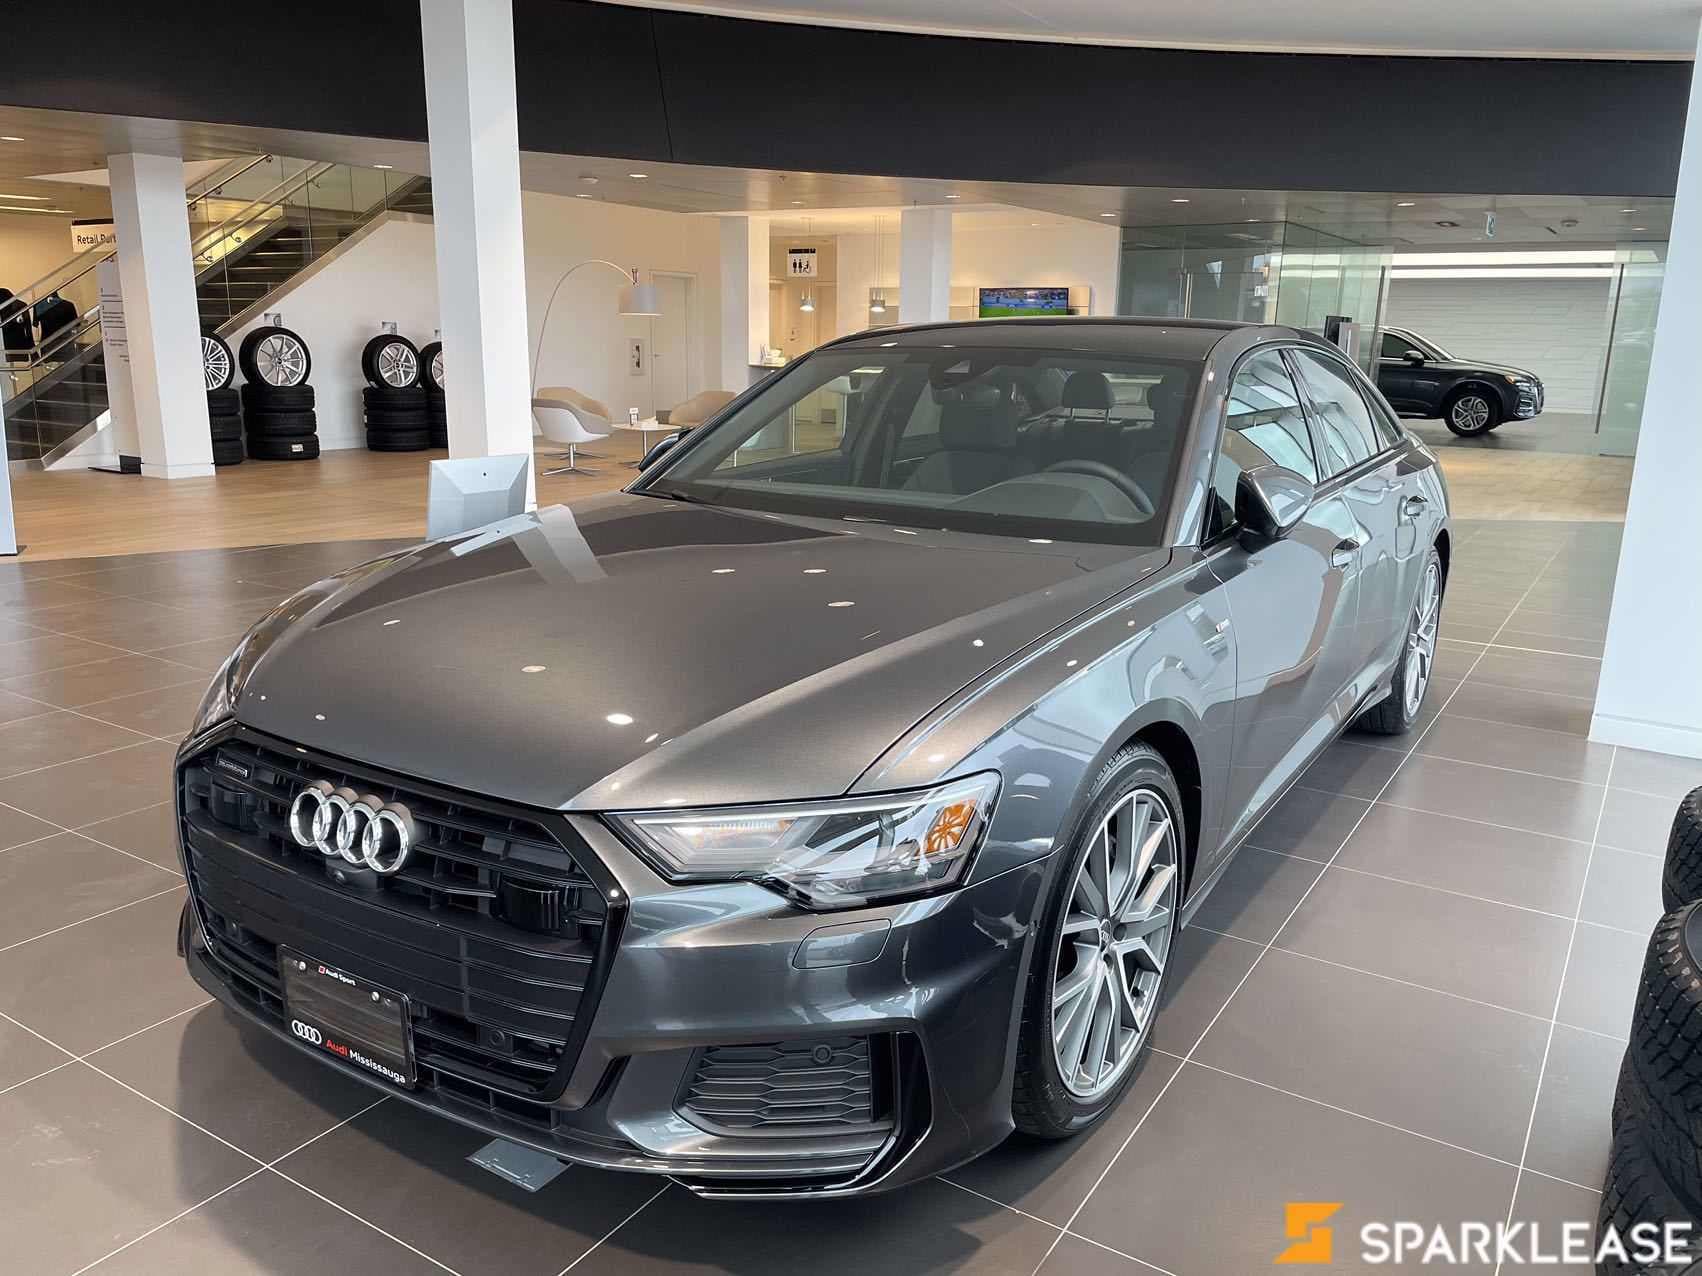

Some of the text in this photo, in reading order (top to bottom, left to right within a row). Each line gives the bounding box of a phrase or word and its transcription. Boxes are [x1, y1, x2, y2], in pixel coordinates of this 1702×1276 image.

[77, 234, 98, 244] Retail
[338, 973, 357, 986] Sport
[326, 1039, 406, 1084] Audi Mississauga
